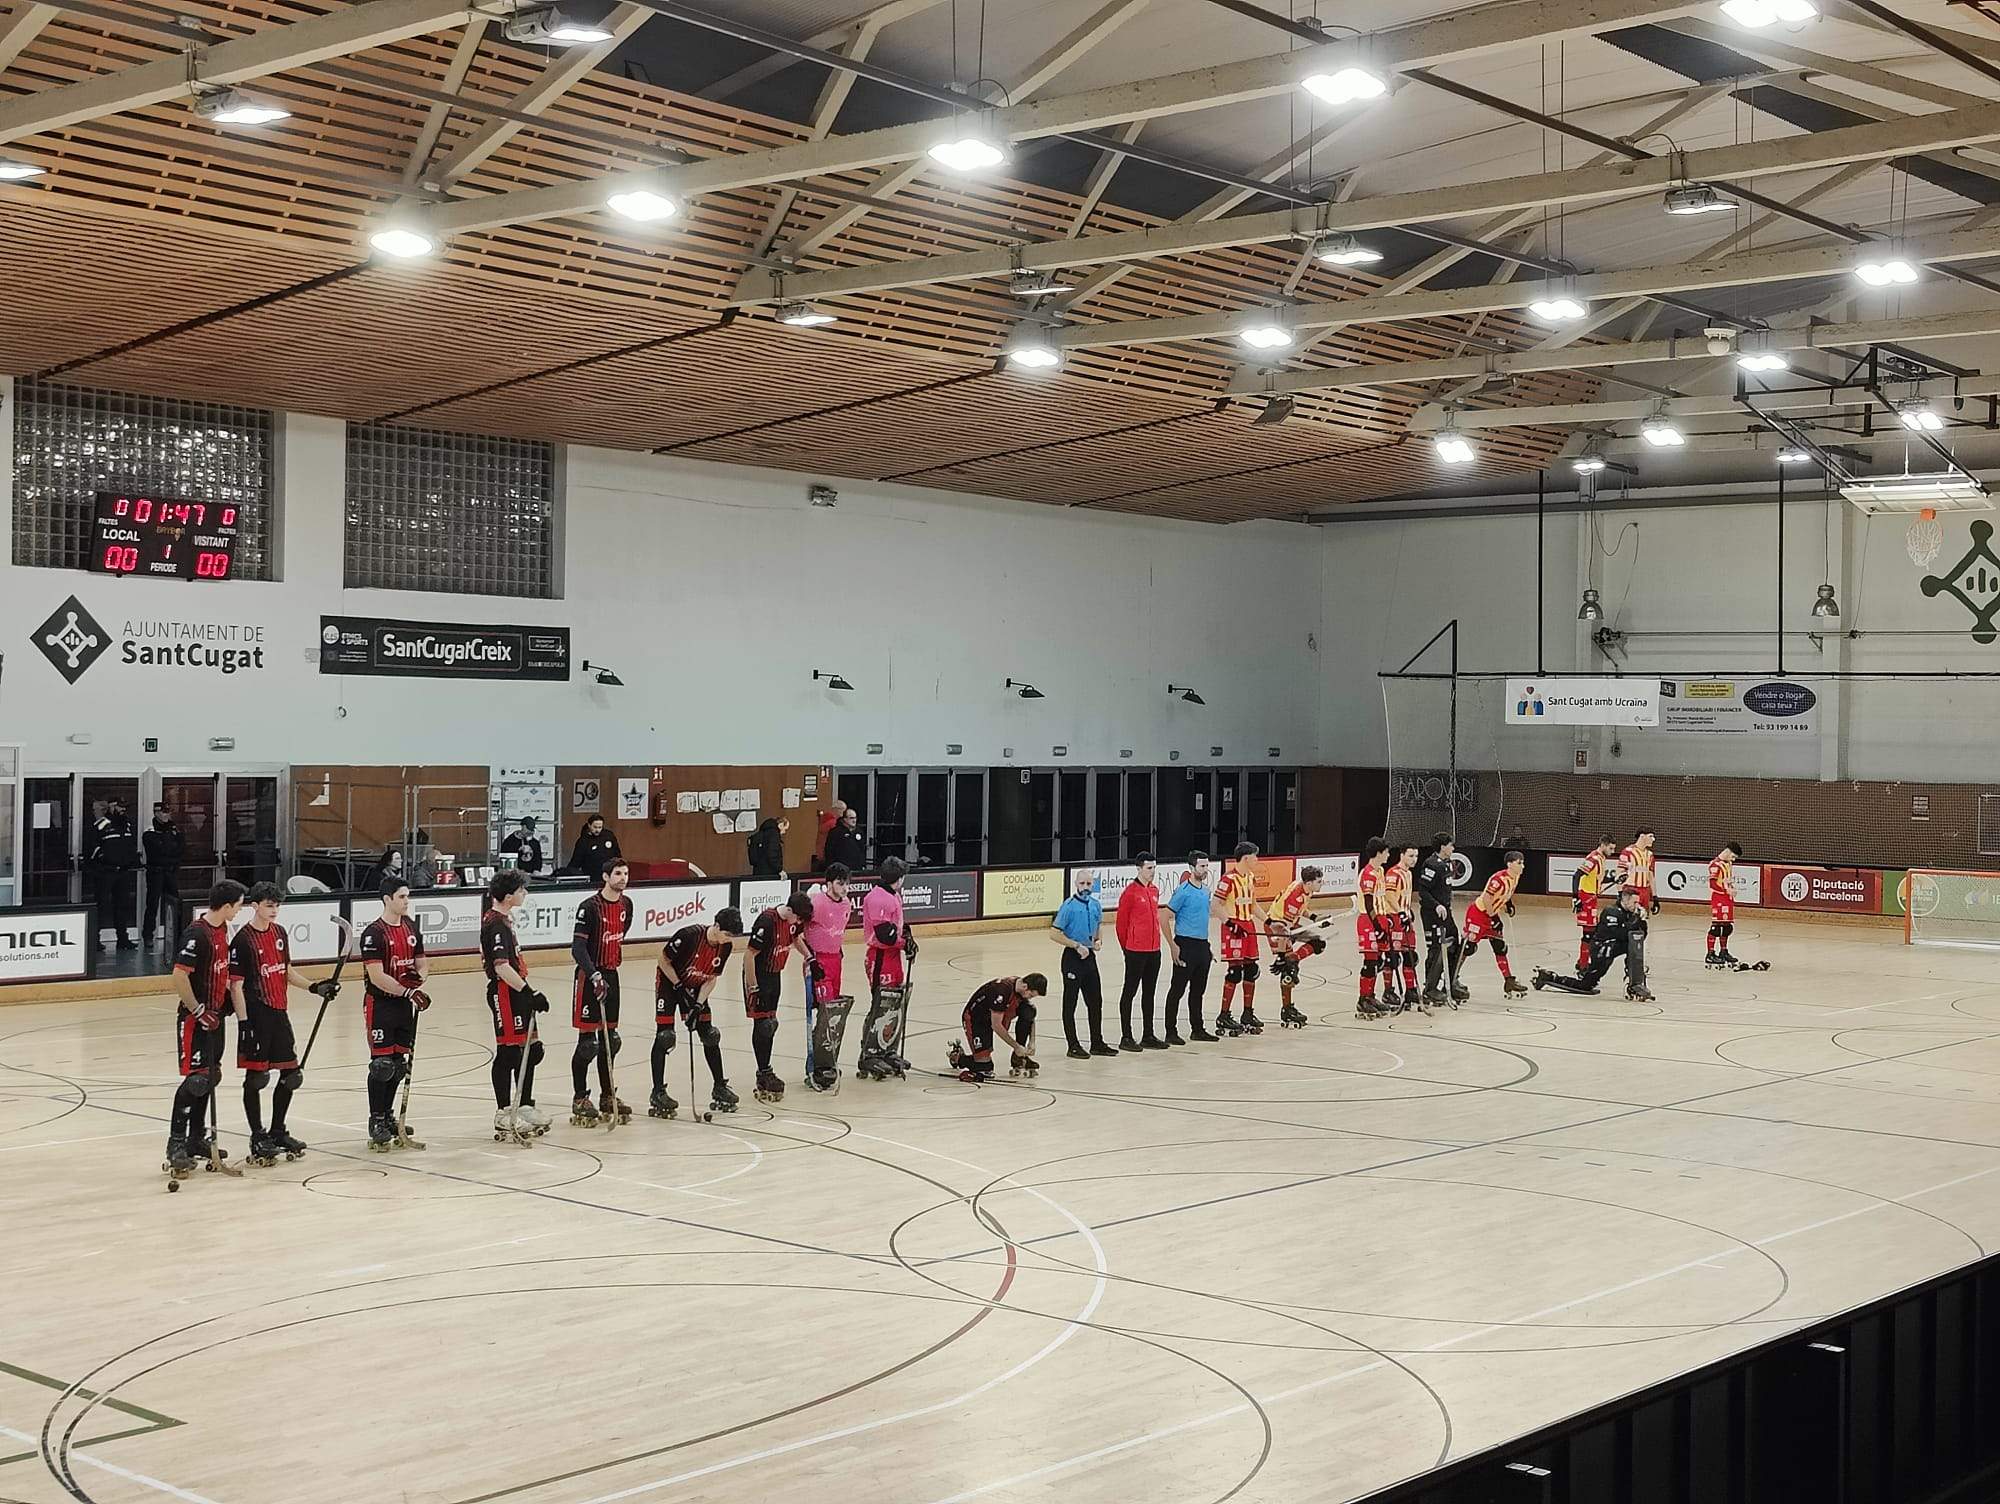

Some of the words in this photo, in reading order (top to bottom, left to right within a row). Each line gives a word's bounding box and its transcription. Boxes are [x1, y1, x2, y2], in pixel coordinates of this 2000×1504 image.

[102, 528, 141, 542] LOCAL
[193, 535, 230, 548] VISITANT
[105, 545, 139, 571] 00
[163, 544, 172, 559] 1
[150, 562, 178, 573] PERIODE
[196, 553, 229, 577] 00
[122, 620, 239, 641] AJUNTAMENT
[243, 626, 265, 642] DE
[383, 633, 512, 665] SantCugatCreix
[121, 640, 264, 674] SantCugat
[1754, 691, 1779, 699] Vendre
[1548, 696, 1567, 706] Sant
[1568, 696, 1593, 708] Cugat
[1594, 696, 1613, 706] amb
[1614, 696, 1648, 707] Ucraïna
[1812, 877, 1865, 891] Diputació
[751, 893, 782, 906] parlem
[902, 895, 932, 905] training
[1812, 890, 1864, 903] Barcelona
[535, 906, 562, 929] FiT
[645, 891, 707, 931] Peusek
[582, 1004, 590, 1015] 6
[656, 998, 665, 1009] 8
[371, 1028, 385, 1041] 93
